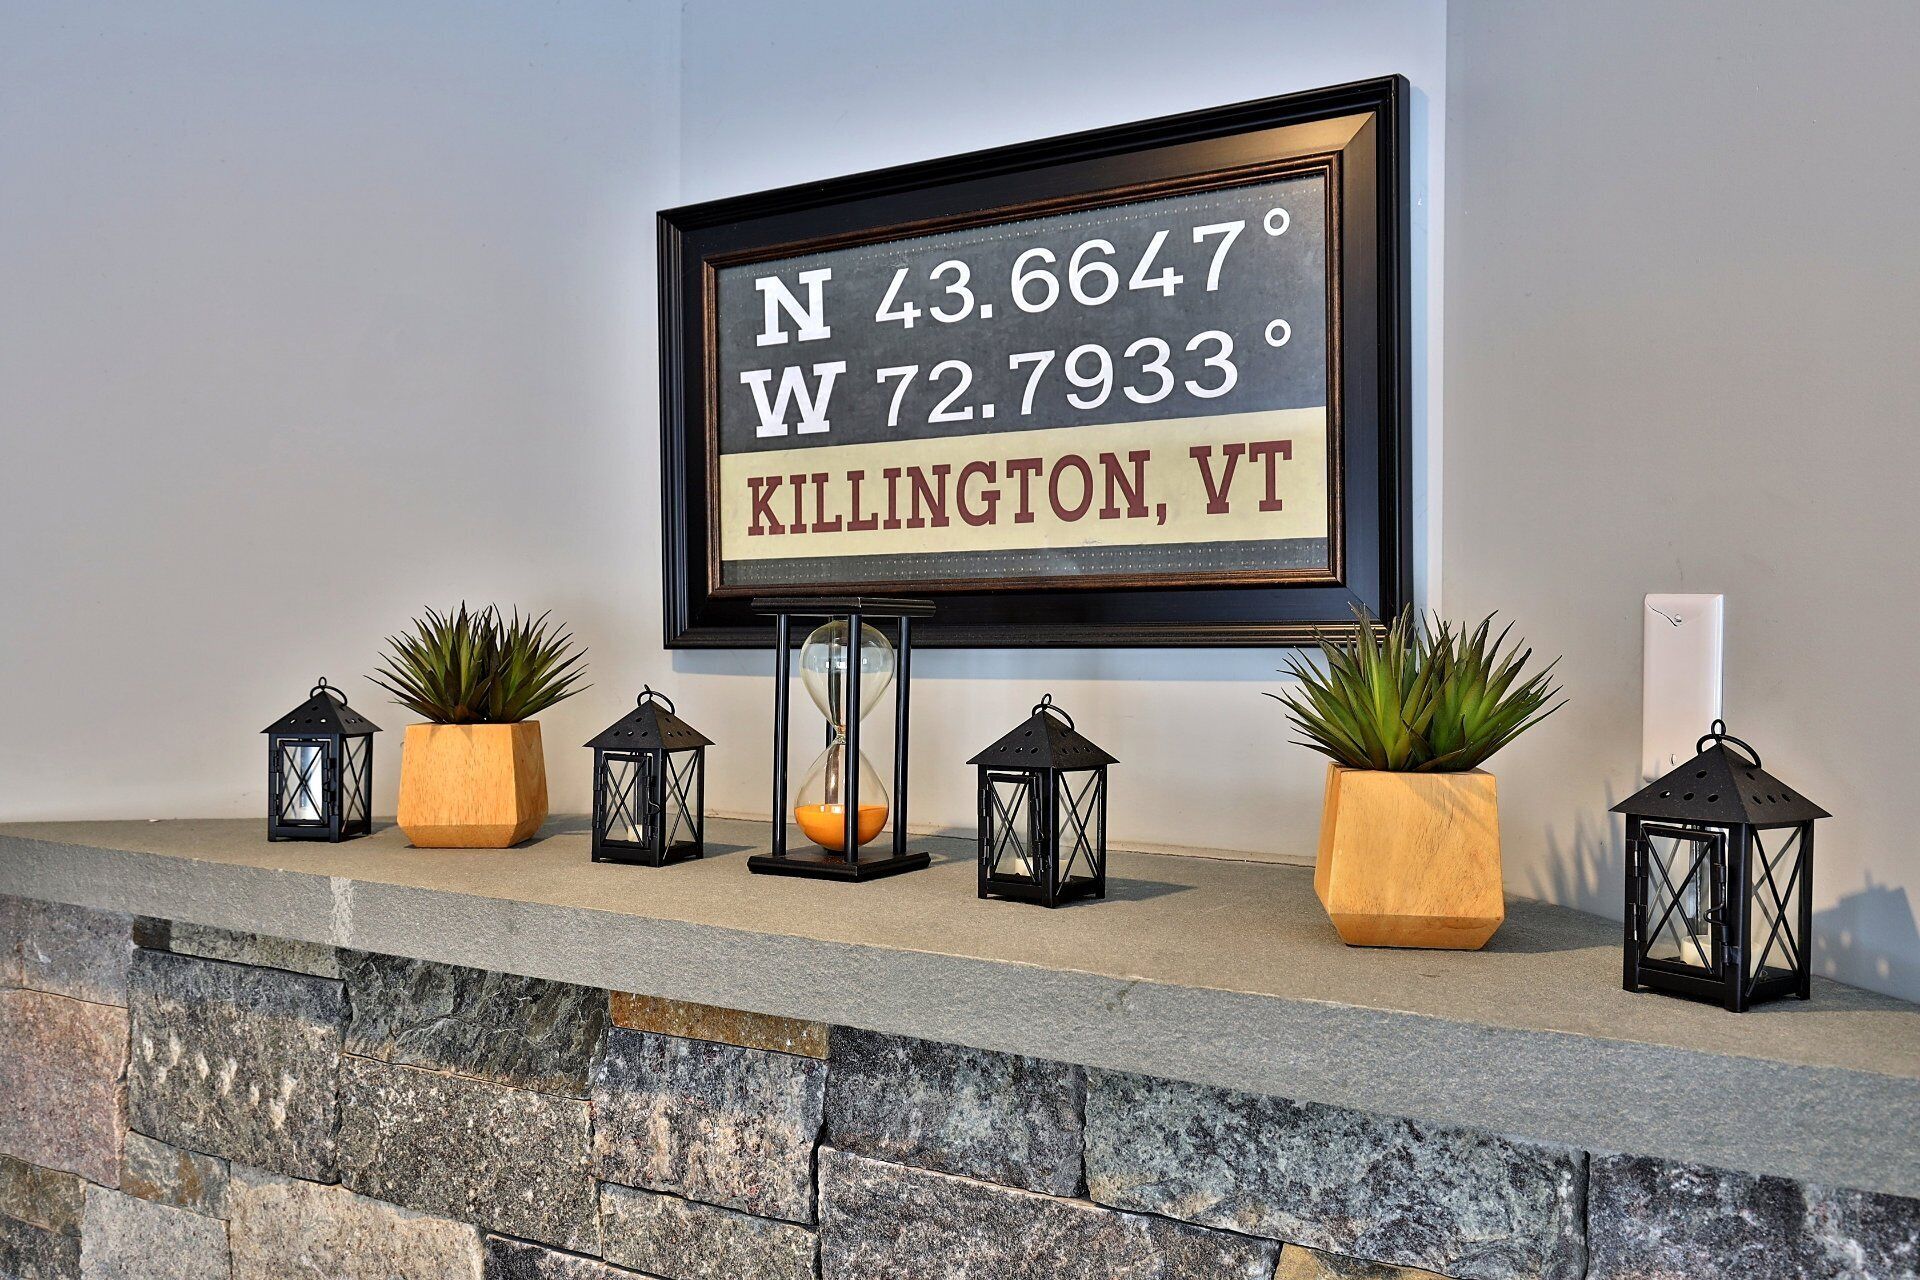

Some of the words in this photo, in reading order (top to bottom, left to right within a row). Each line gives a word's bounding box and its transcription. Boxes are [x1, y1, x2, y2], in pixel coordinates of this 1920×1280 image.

[755, 267, 832, 347] N
[740, 360, 847, 438] W
[747, 449, 1167, 536] KILLINGTON,
[1190, 439, 1293, 516] VT
